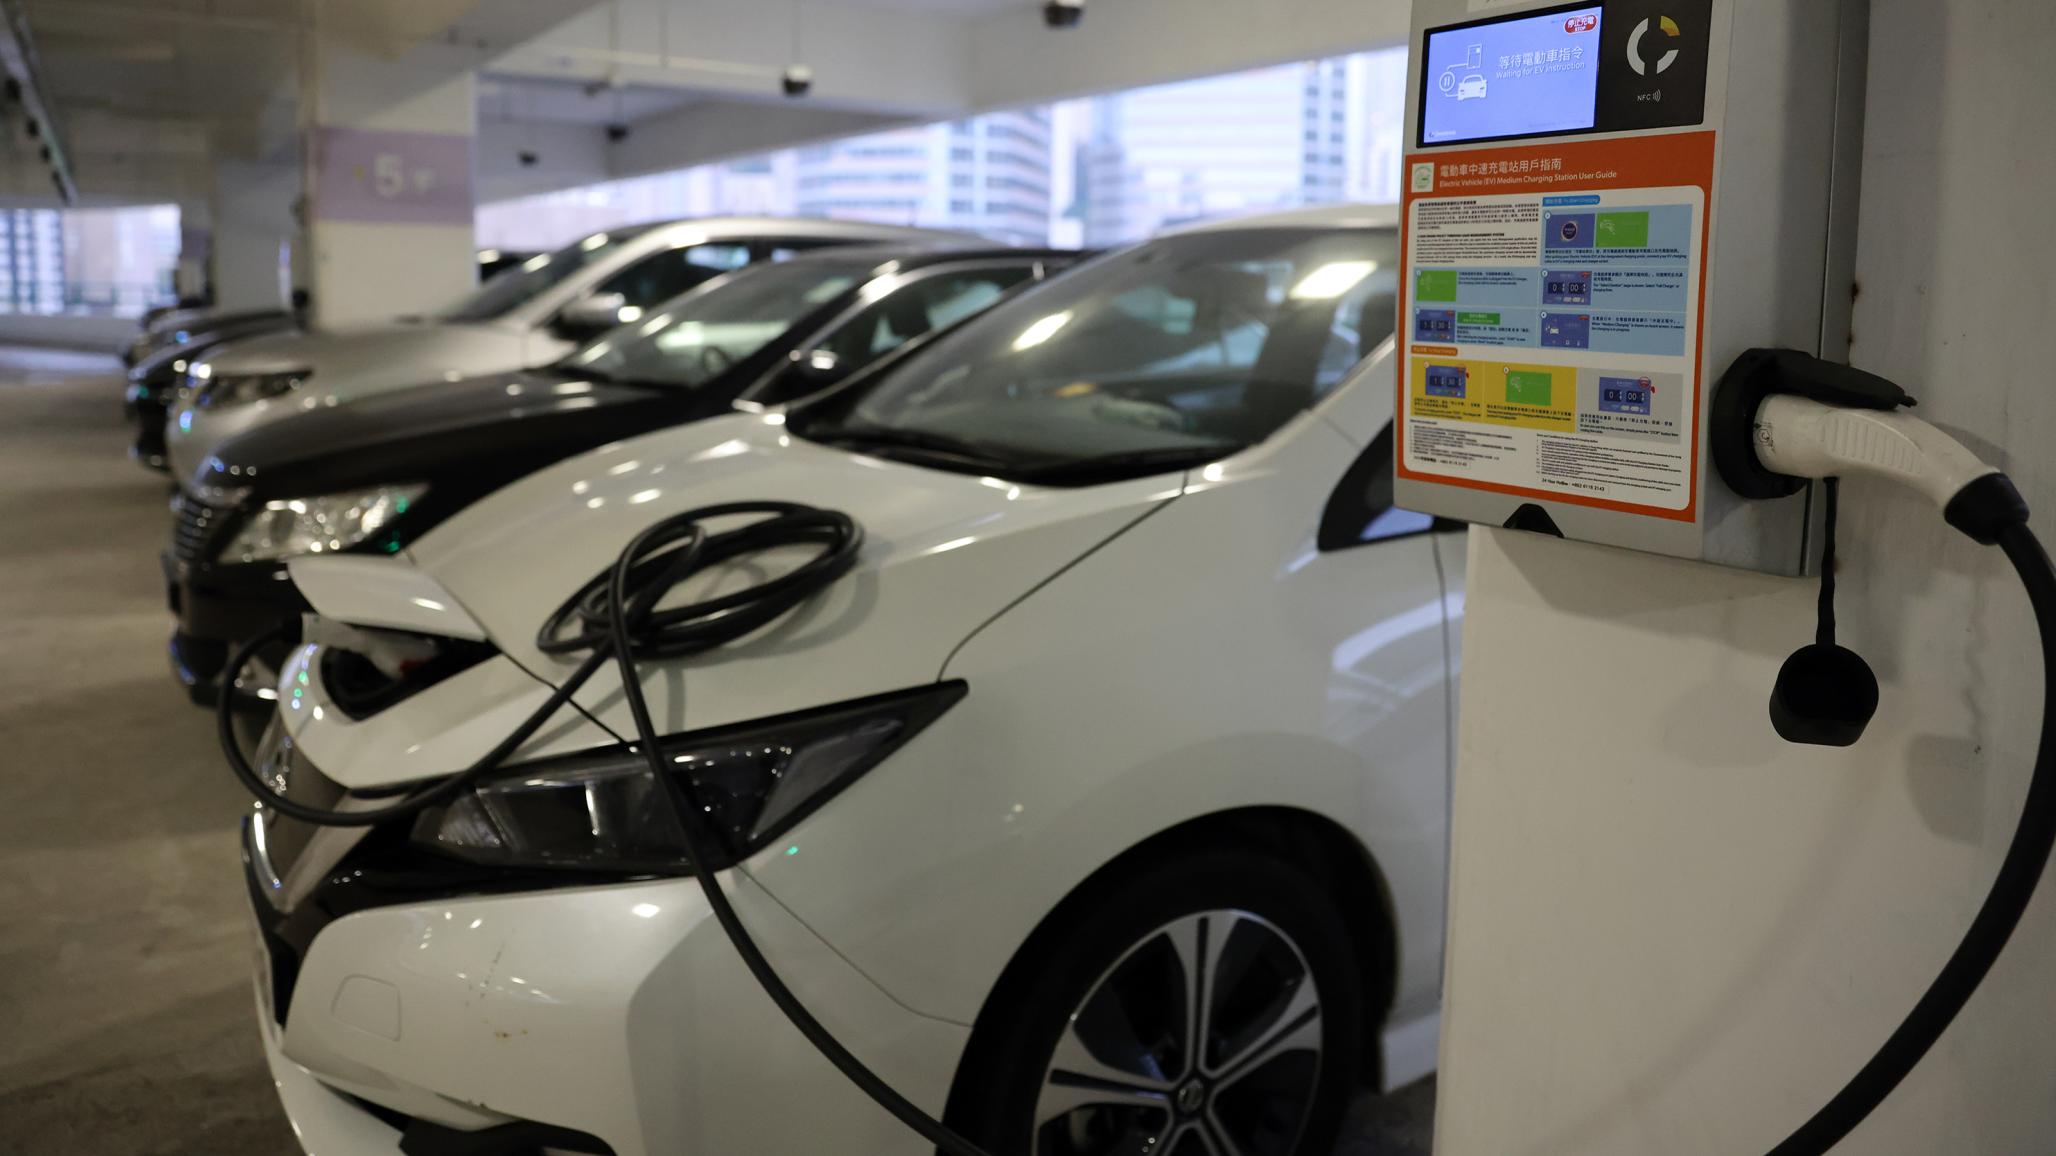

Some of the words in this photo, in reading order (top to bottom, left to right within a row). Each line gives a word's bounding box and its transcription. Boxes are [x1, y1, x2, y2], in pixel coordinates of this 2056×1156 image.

[1499, 46, 1584, 70] 等待電動車指令
[1496, 69, 1522, 79] Waiting
[1523, 67, 1533, 77] for
[1534, 66, 1545, 74] EV
[1637, 93, 1651, 102] NFC
[1440, 157, 1562, 177] 電動車中速充電站用戶指南
[1461, 178, 1483, 186] Vehicle
[1484, 177, 1497, 185] (EV)
[1497, 176, 1522, 184] Medium
[1523, 174, 1553, 184] Charging
[1554, 172, 1578, 181] Station
[1579, 171, 1594, 180] User
[1595, 169, 1617, 179] Guide
